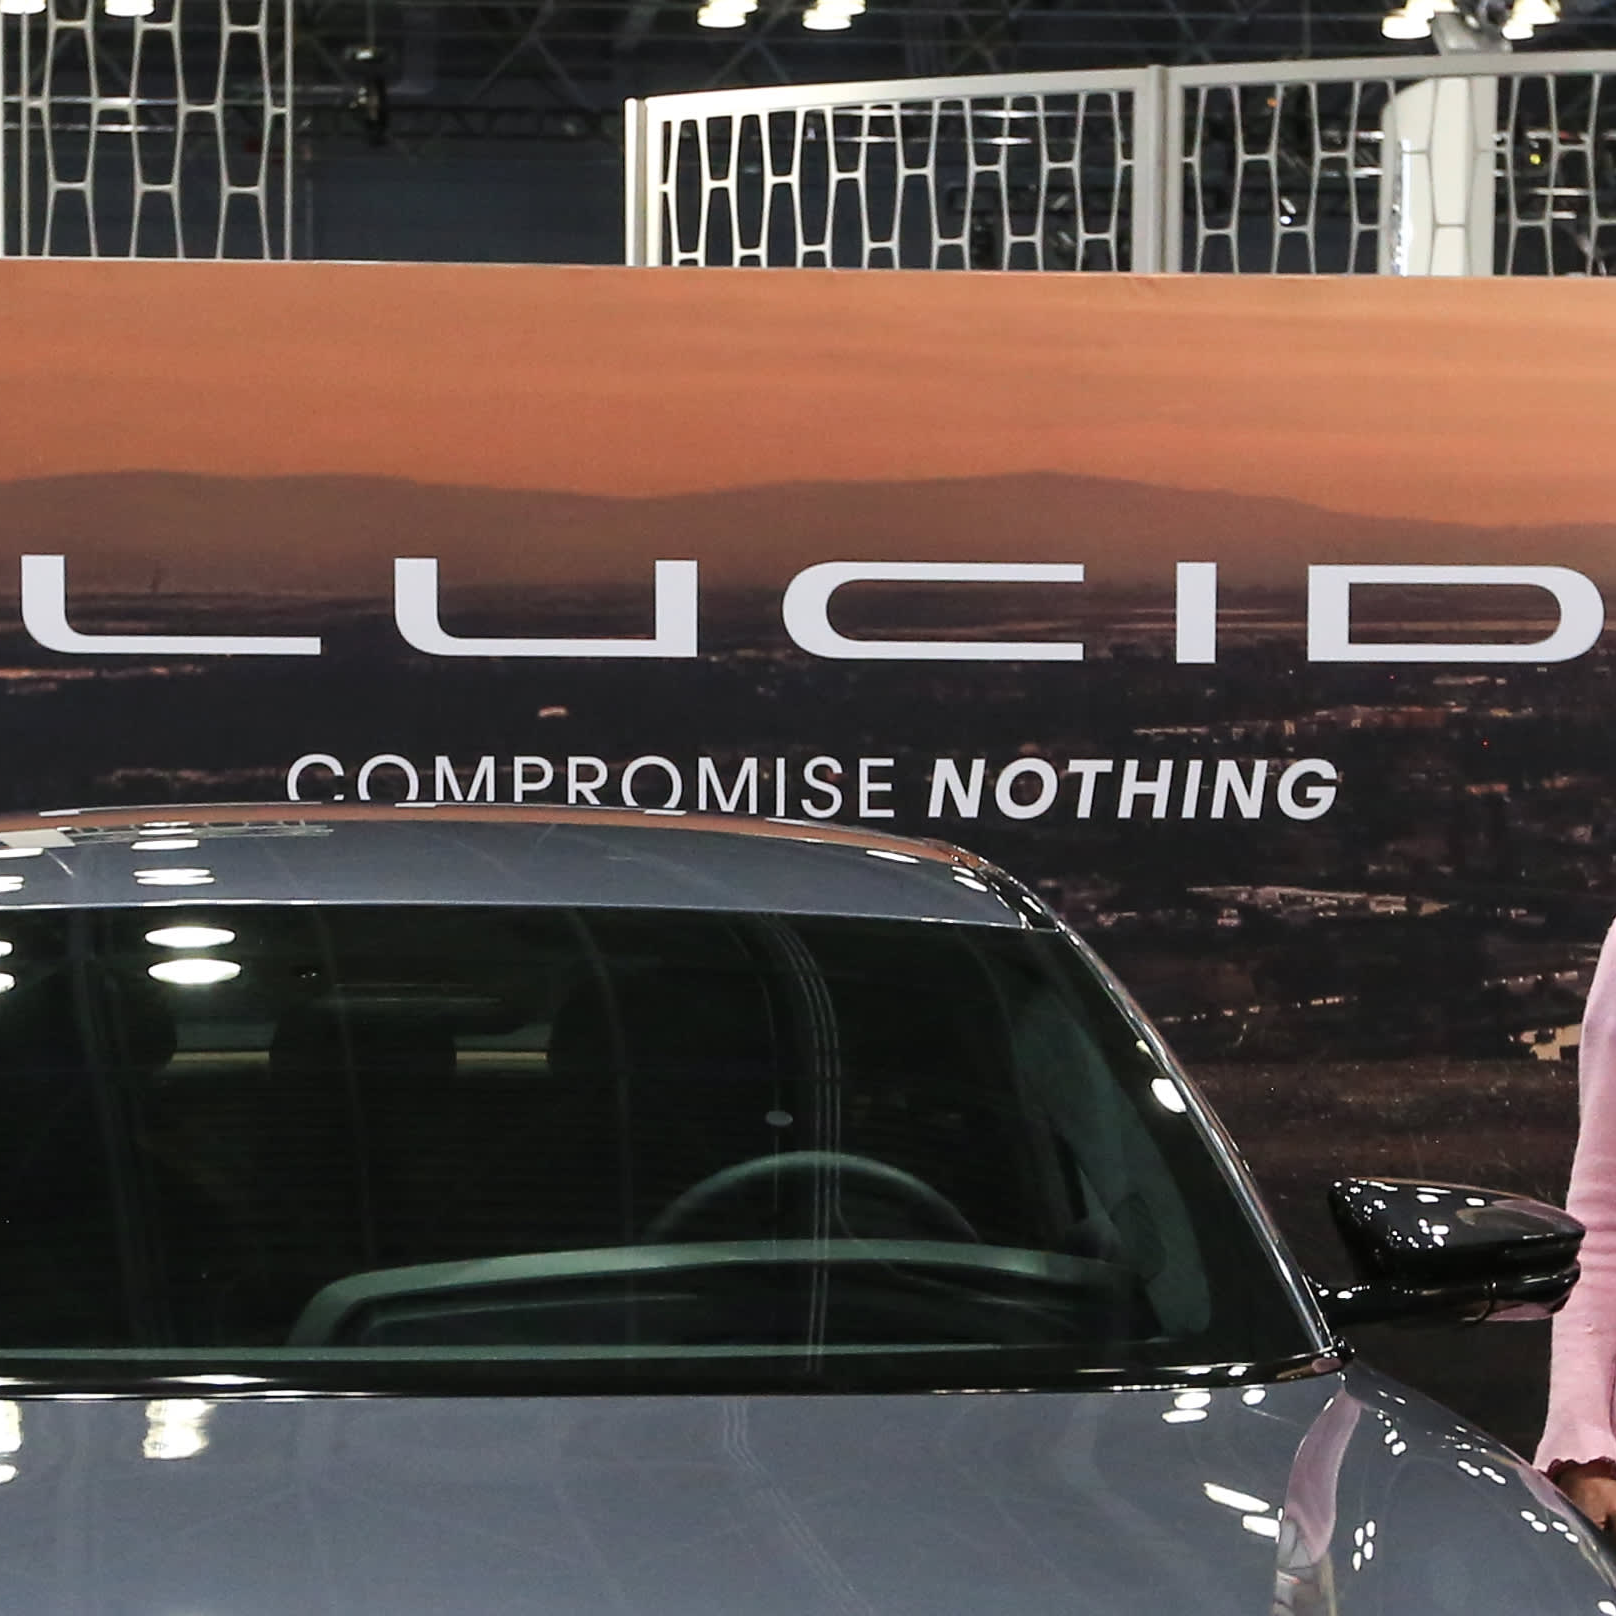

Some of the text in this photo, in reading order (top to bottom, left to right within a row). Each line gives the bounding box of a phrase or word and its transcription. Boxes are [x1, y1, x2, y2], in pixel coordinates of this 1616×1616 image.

[20, 554, 1605, 663] LUCID
[287, 754, 1339, 820] COMPROMISE NOTHING
